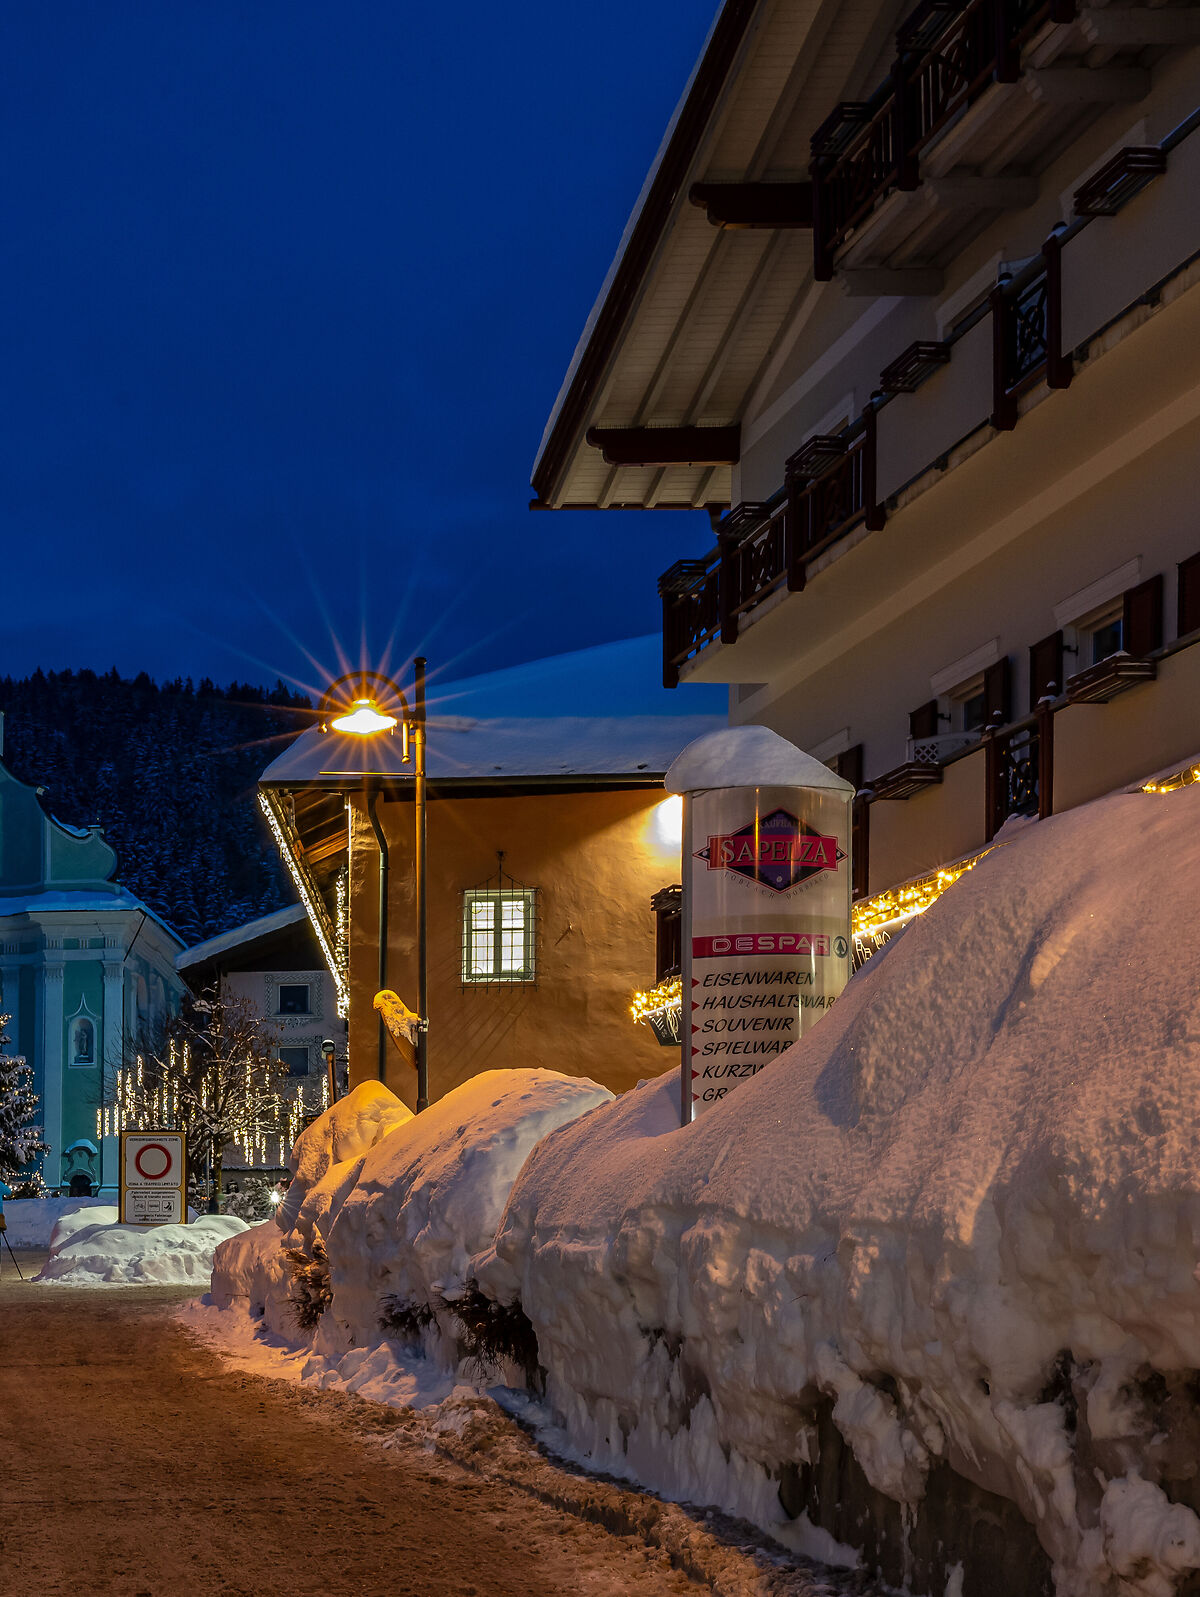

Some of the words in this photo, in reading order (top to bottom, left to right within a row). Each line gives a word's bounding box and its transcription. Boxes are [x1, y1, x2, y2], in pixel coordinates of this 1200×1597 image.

[720, 839, 829, 864] SAPELZA
[712, 936, 828, 953] DESPAR
[702, 971, 817, 988] EISENWAREN
[702, 993, 836, 1010] HAUSHALTSWAR
[701, 1017, 795, 1033] SOUVENIR
[701, 1040, 794, 1056] SPIELWAR
[702, 1064, 765, 1079] KURZW
[702, 1087, 728, 1102] GR
